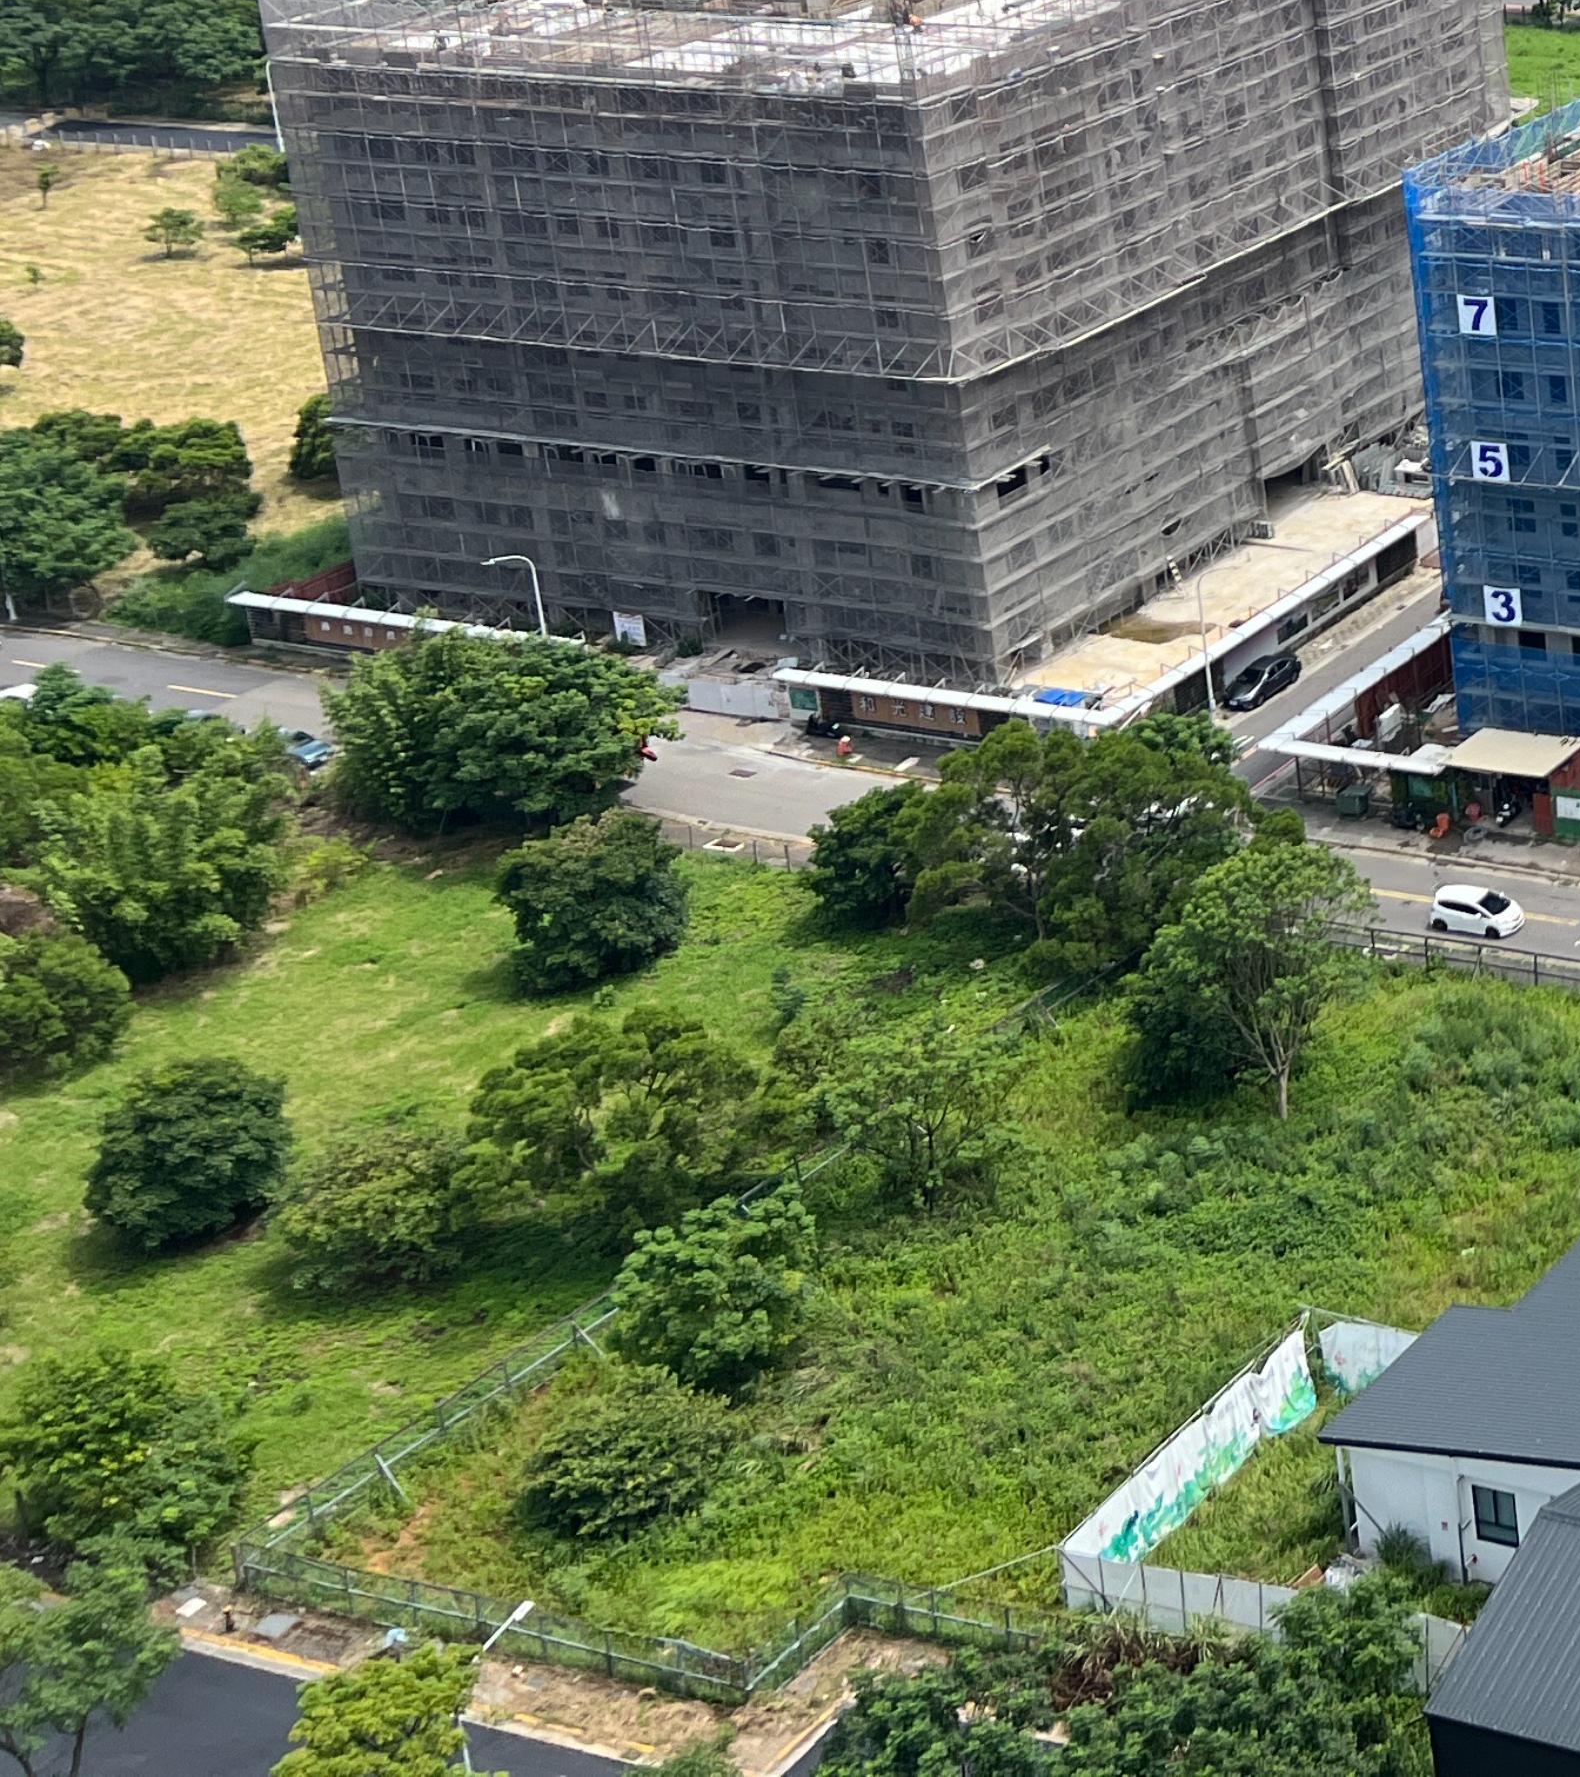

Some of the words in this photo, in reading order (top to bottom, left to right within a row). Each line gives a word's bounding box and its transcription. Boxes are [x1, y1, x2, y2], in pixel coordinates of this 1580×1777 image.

[1463, 297, 1488, 331] 7
[1478, 444, 1503, 477] 5
[1491, 590, 1517, 622] 3
